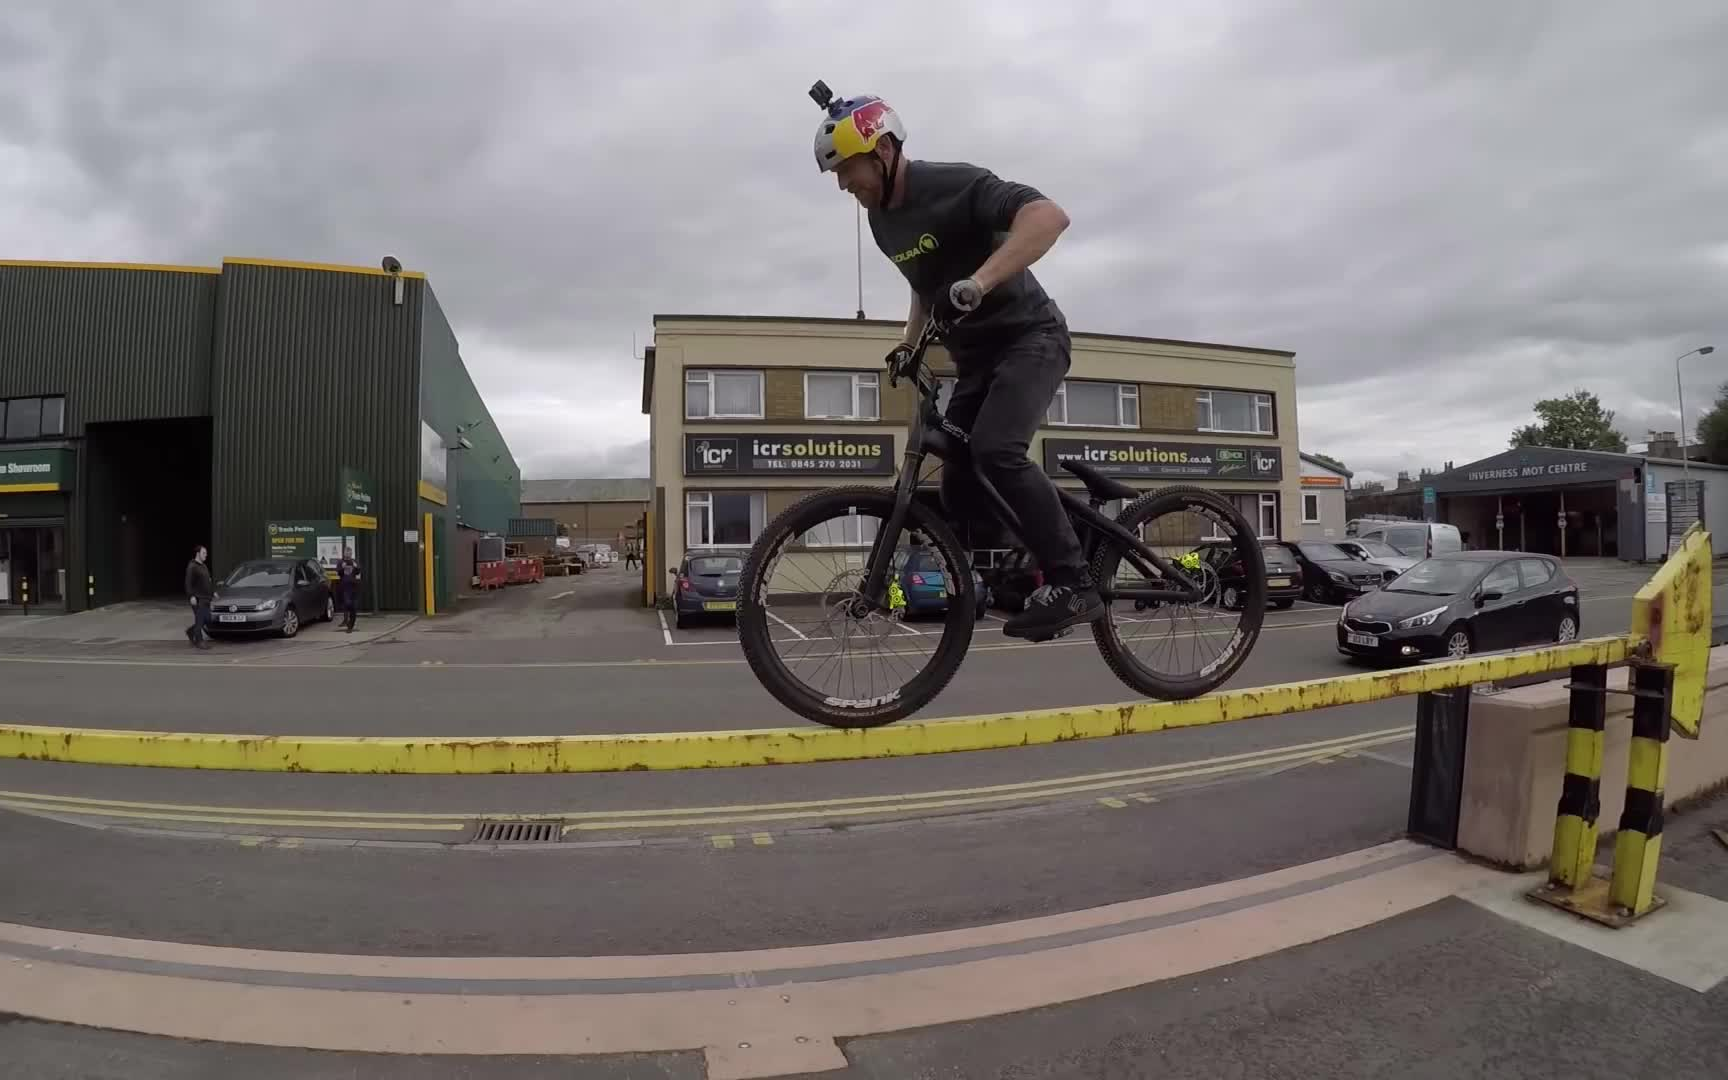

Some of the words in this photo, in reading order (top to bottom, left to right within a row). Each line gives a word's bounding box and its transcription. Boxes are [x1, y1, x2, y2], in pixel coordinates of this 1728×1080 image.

[753, 439, 881, 456] icrsolutions
[1056, 444, 1212, 464] www.icrsolutions.co.uk
[8, 462, 51, 474] Showroom
[791, 460, 815, 469] 0845
[819, 460, 836, 469] 270
[840, 460, 861, 469] 2031
[1468, 468, 1518, 481] INVERNESS
[1521, 465, 1545, 477] MOT
[1547, 462, 1588, 474] CENTRE
